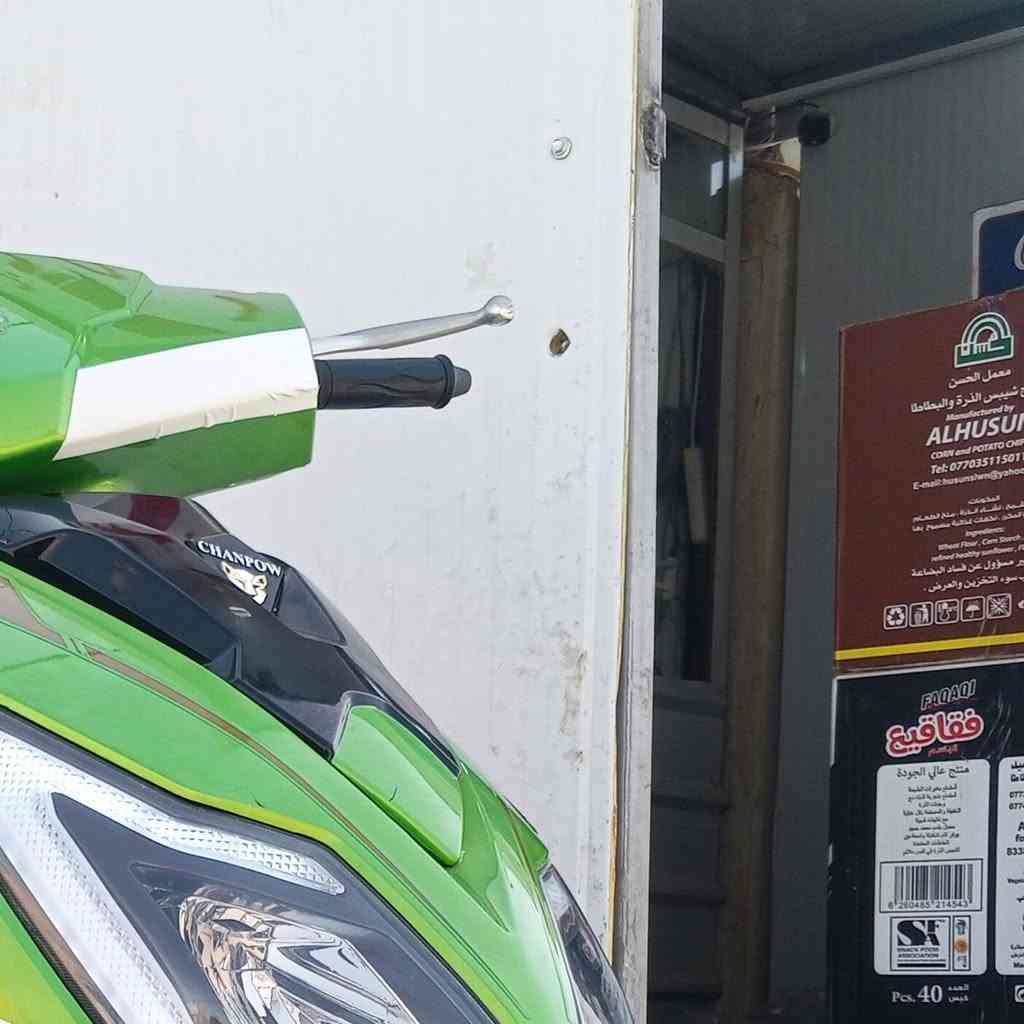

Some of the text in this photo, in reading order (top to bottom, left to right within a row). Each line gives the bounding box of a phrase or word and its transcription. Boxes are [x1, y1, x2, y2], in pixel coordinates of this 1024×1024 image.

[948, 368, 1012, 389] معمل الحسن
[911, 397, 954, 413] والبطاطا
[956, 391, 982, 408] الذرة
[1003, 404, 1016, 414] by
[930, 449, 954, 460] CORN
[954, 446, 971, 457] and
[972, 441, 1005, 454] POTATO
[930, 462, 948, 475] Tel:
[197, 540, 282, 577] CHANPOW
[885, 707, 985, 758] فقاقيع
[896, 765, 970, 780] منتج عالي الجودة
[891, 984, 943, 1003] Pcs. 40
